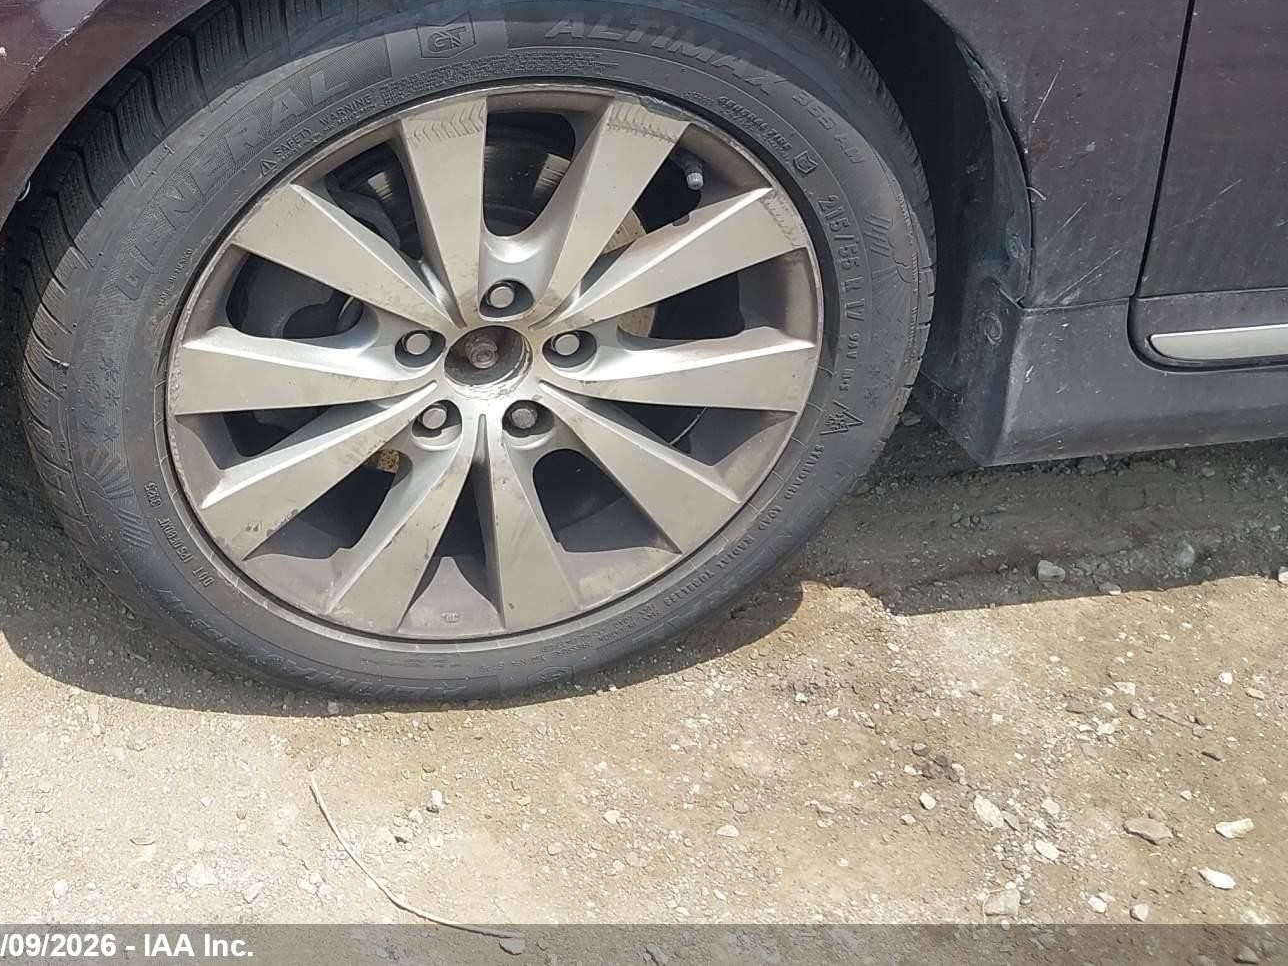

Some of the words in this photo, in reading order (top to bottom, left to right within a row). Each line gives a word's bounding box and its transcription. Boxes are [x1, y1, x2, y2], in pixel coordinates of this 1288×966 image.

[544, 13, 787, 95] ALTIMAX
[272, 126, 313, 156] SAFETY
[318, 95, 373, 126] WARNING
[114, 69, 350, 301] GENERAL
[817, 193, 860, 271] 215/55
[191, 566, 215, 587] DOT
